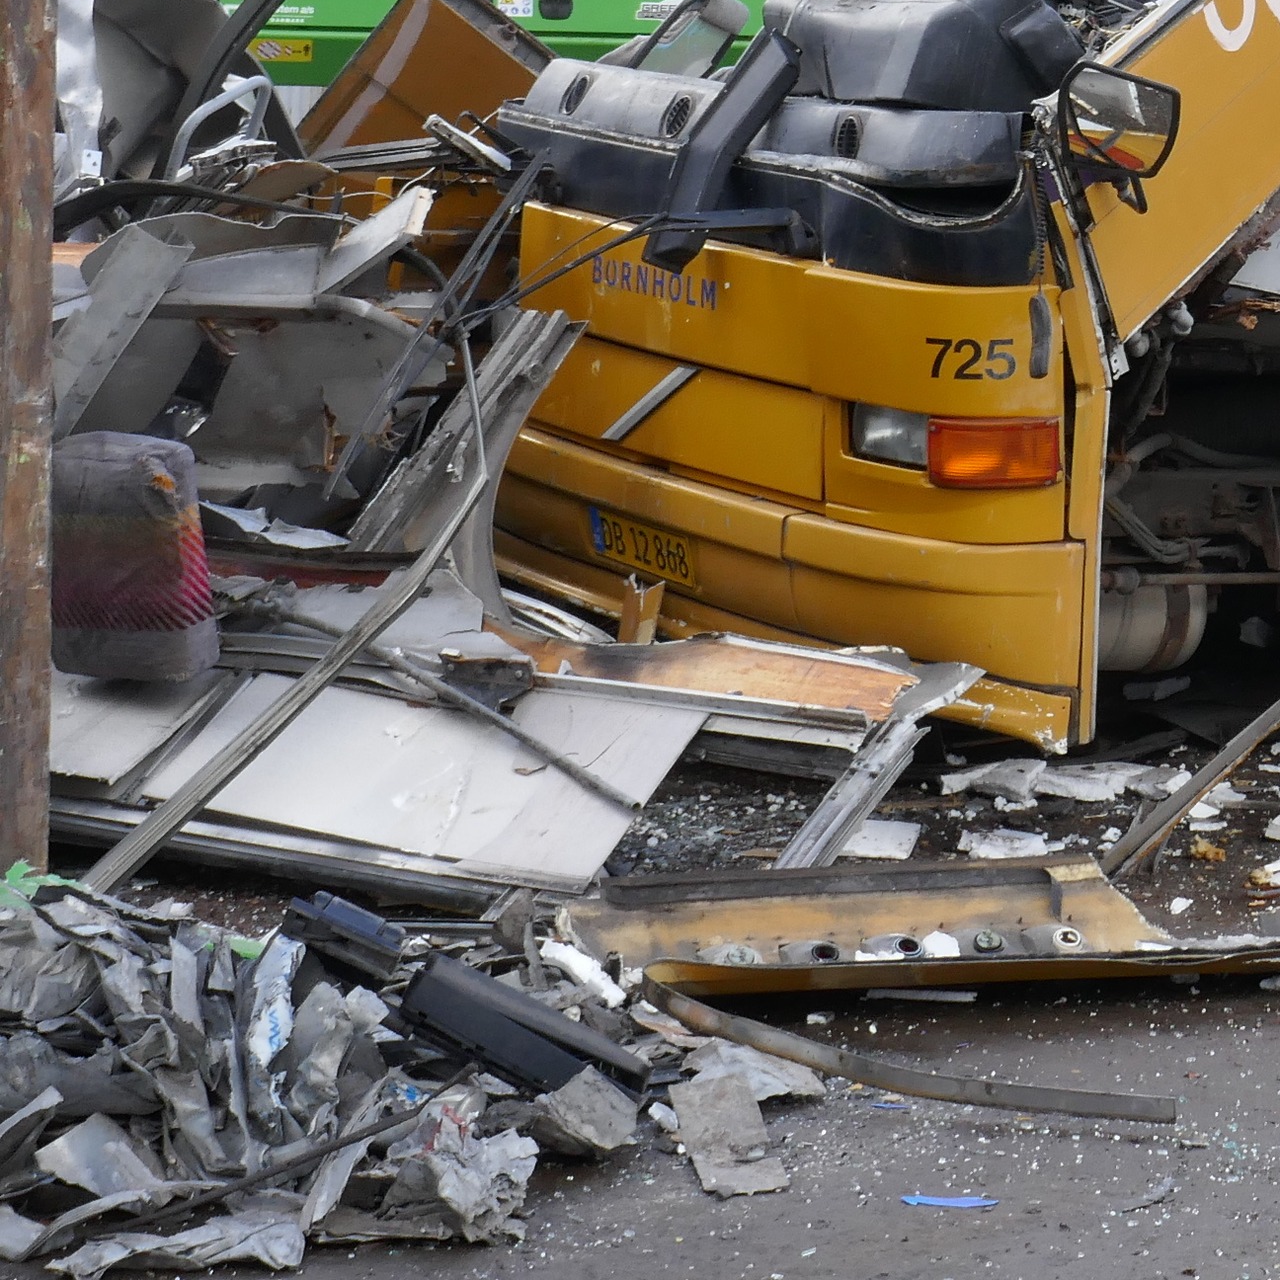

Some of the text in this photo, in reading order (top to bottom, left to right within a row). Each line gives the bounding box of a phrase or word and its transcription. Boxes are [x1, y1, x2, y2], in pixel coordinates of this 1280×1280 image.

[592, 254, 717, 311] BORNHOLM
[926, 337, 1016, 380] 725
[600, 517, 626, 556] DB
